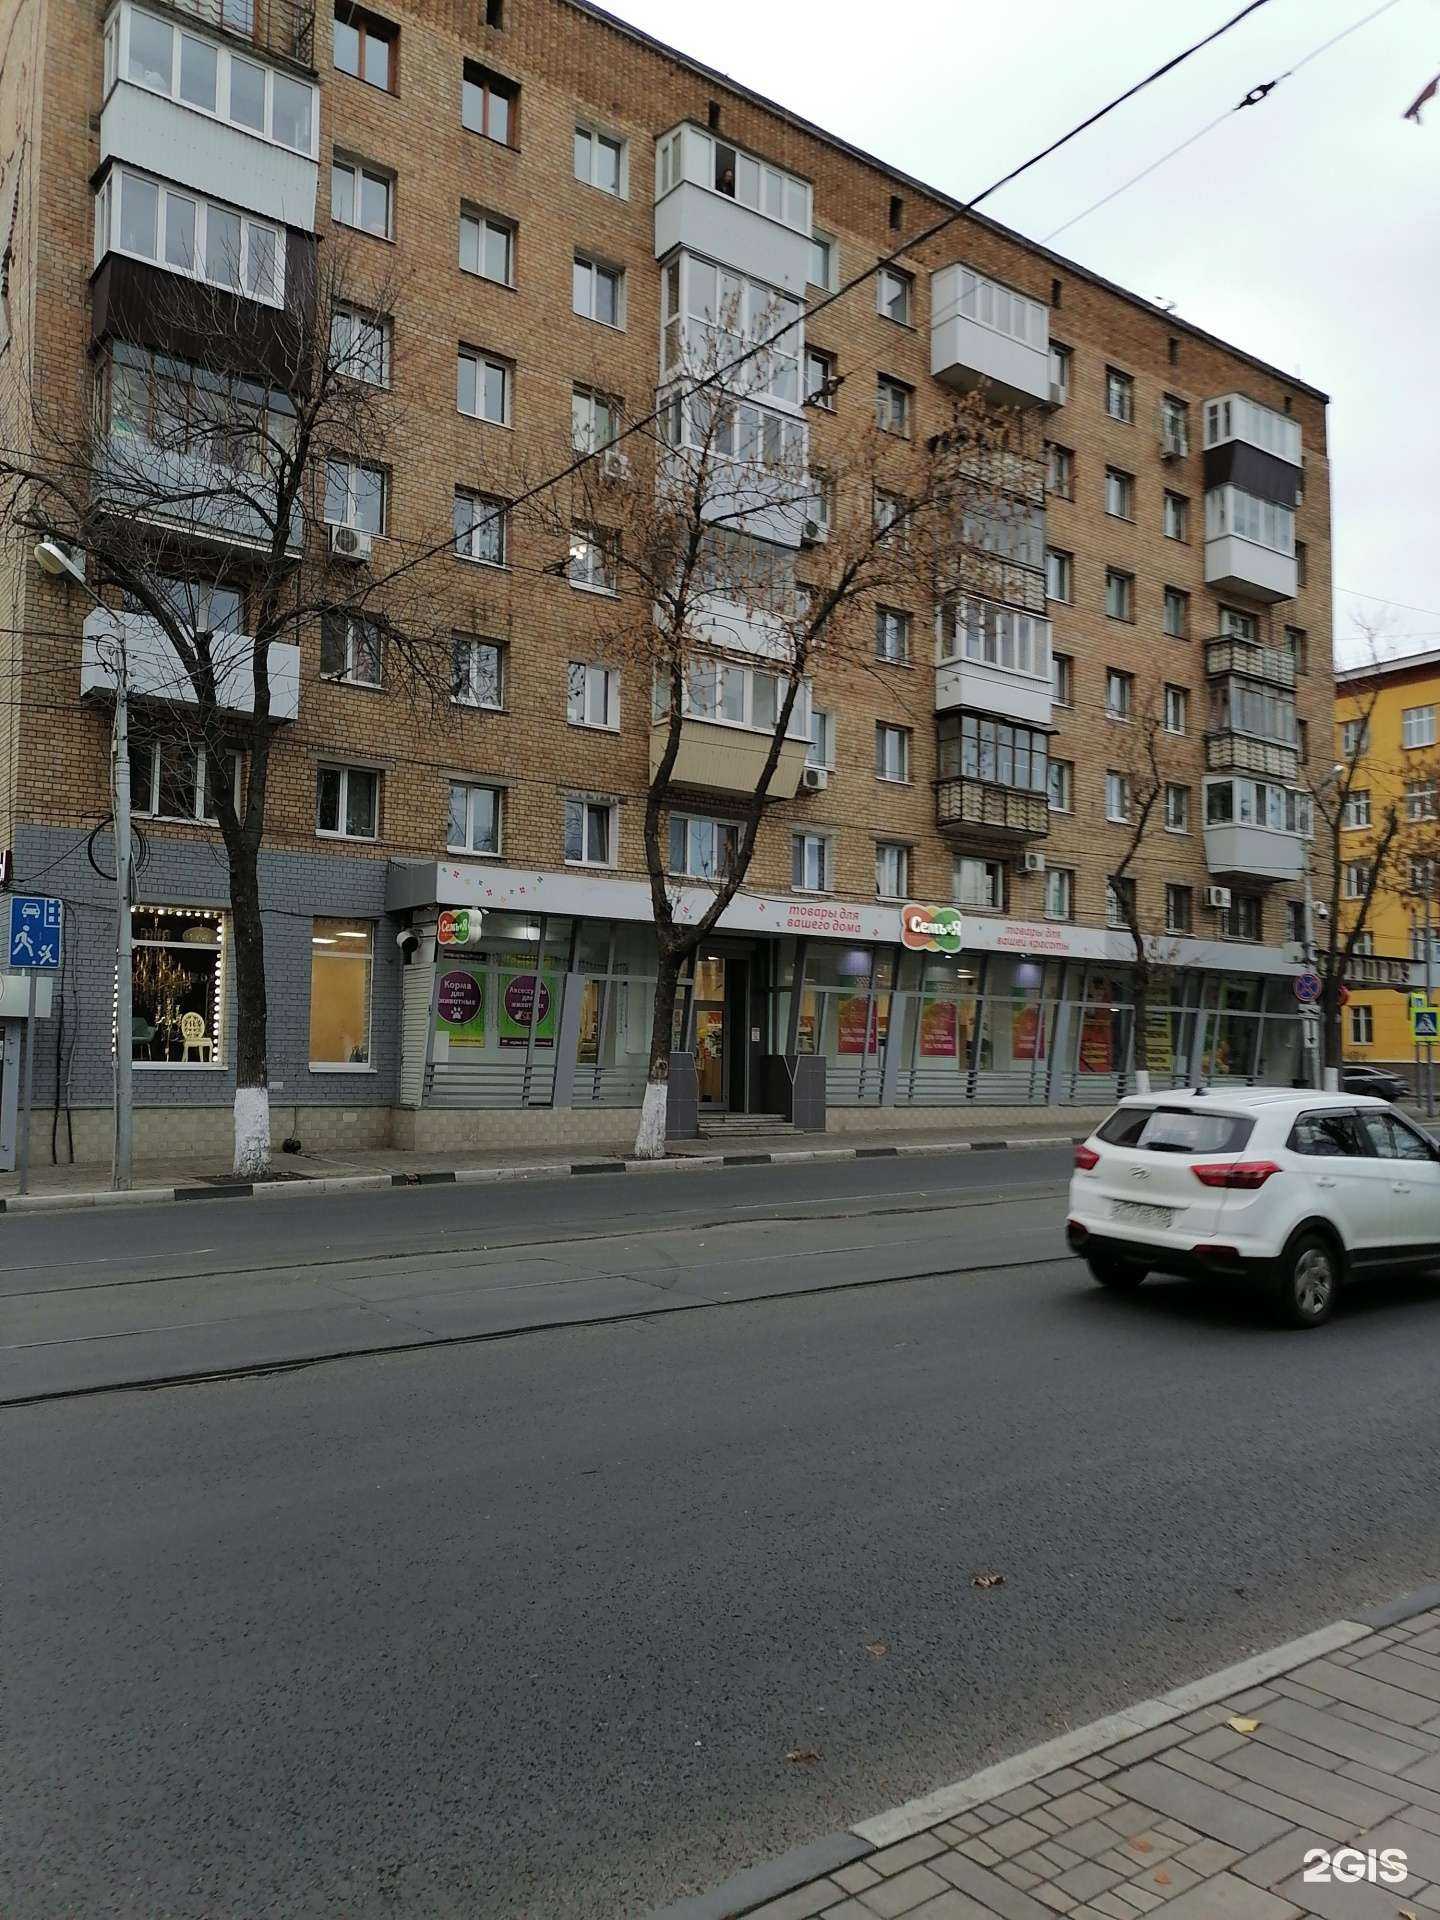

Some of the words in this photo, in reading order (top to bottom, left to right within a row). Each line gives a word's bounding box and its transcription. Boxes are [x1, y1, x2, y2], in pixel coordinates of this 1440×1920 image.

[789, 905, 837, 920] товары
[840, 907, 860, 920] для
[787, 918, 830, 931] вашего
[833, 919, 861, 933] дома
[444, 980, 472, 991] Корма
